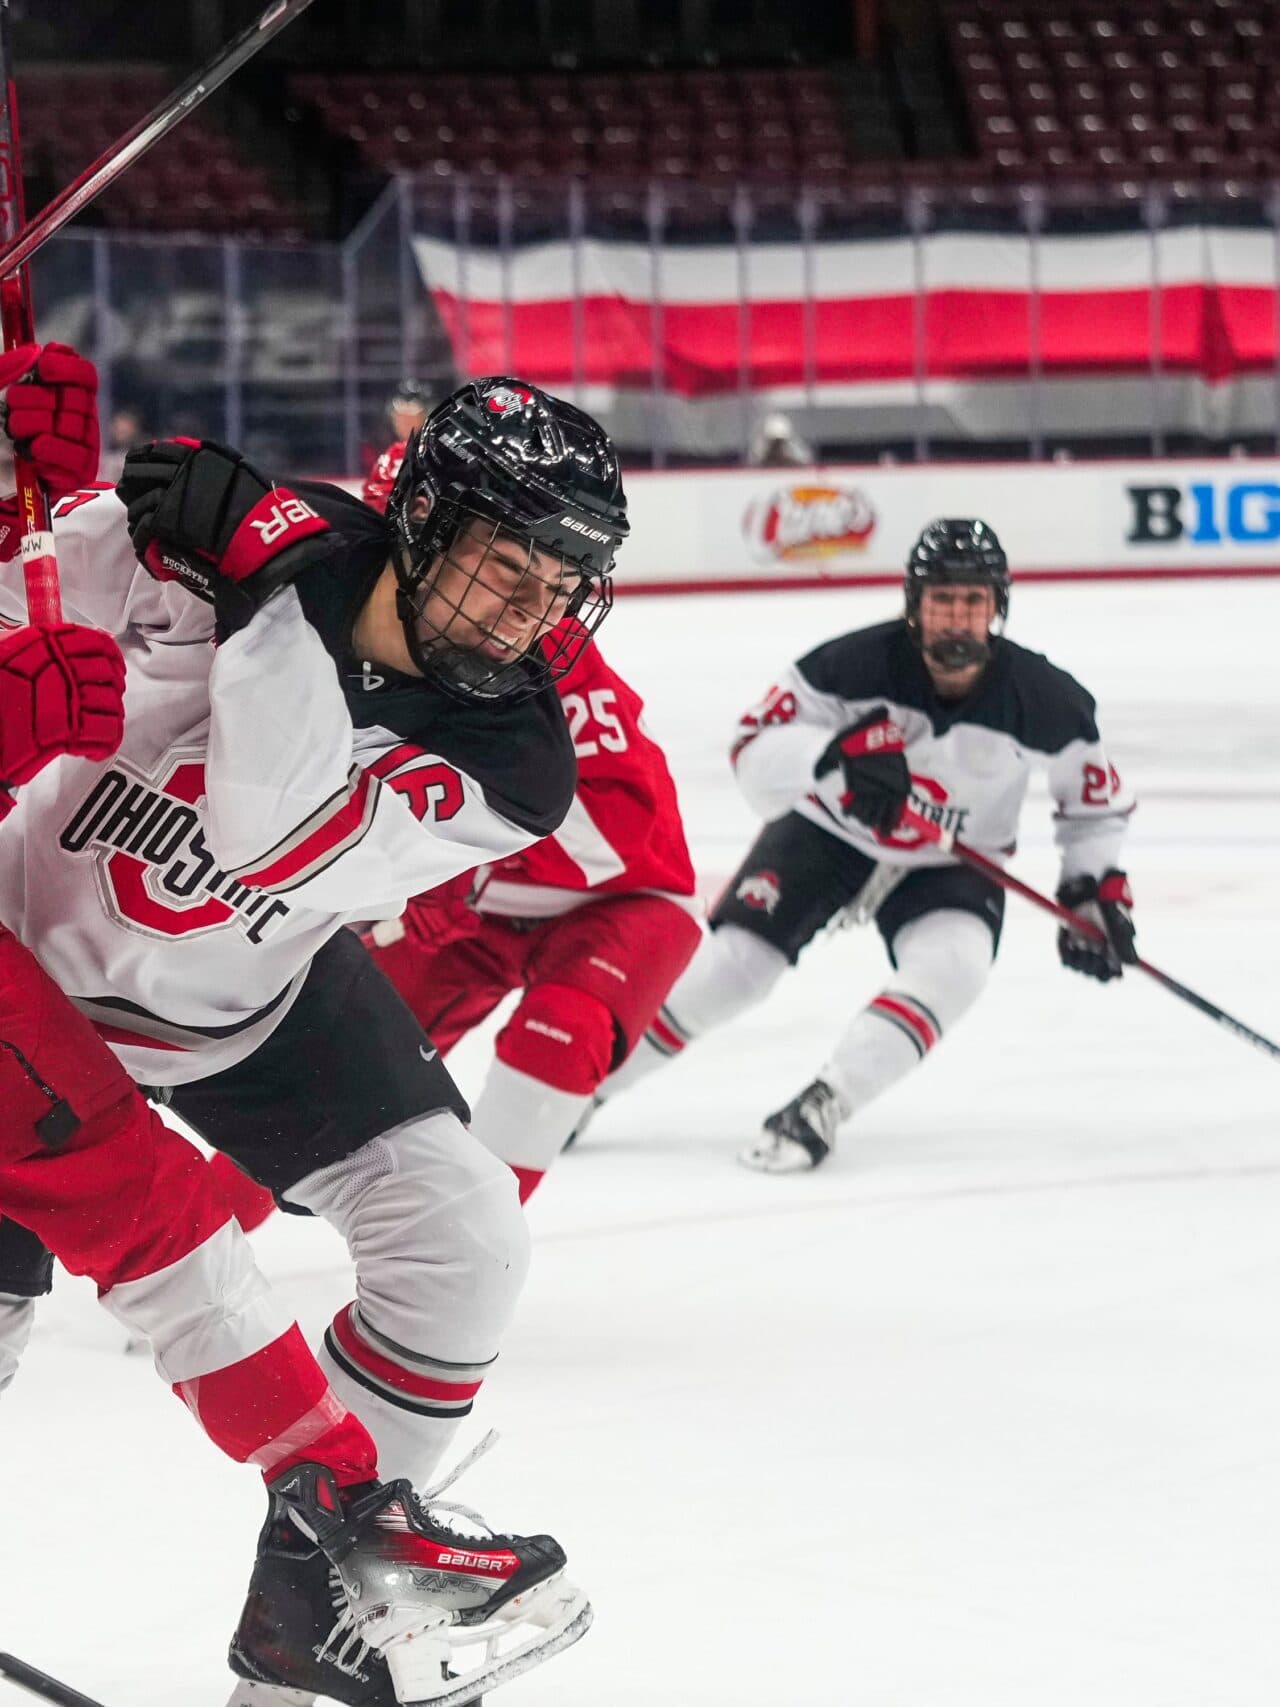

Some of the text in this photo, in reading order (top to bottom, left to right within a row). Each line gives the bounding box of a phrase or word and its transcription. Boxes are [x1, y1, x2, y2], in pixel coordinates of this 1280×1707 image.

[559, 516, 611, 544] BAUER
[162, 555, 209, 586] BUCKEYES
[561, 689, 628, 758] 25
[59, 769, 199, 866] OHIO
[437, 1553, 503, 1571] BAUER
